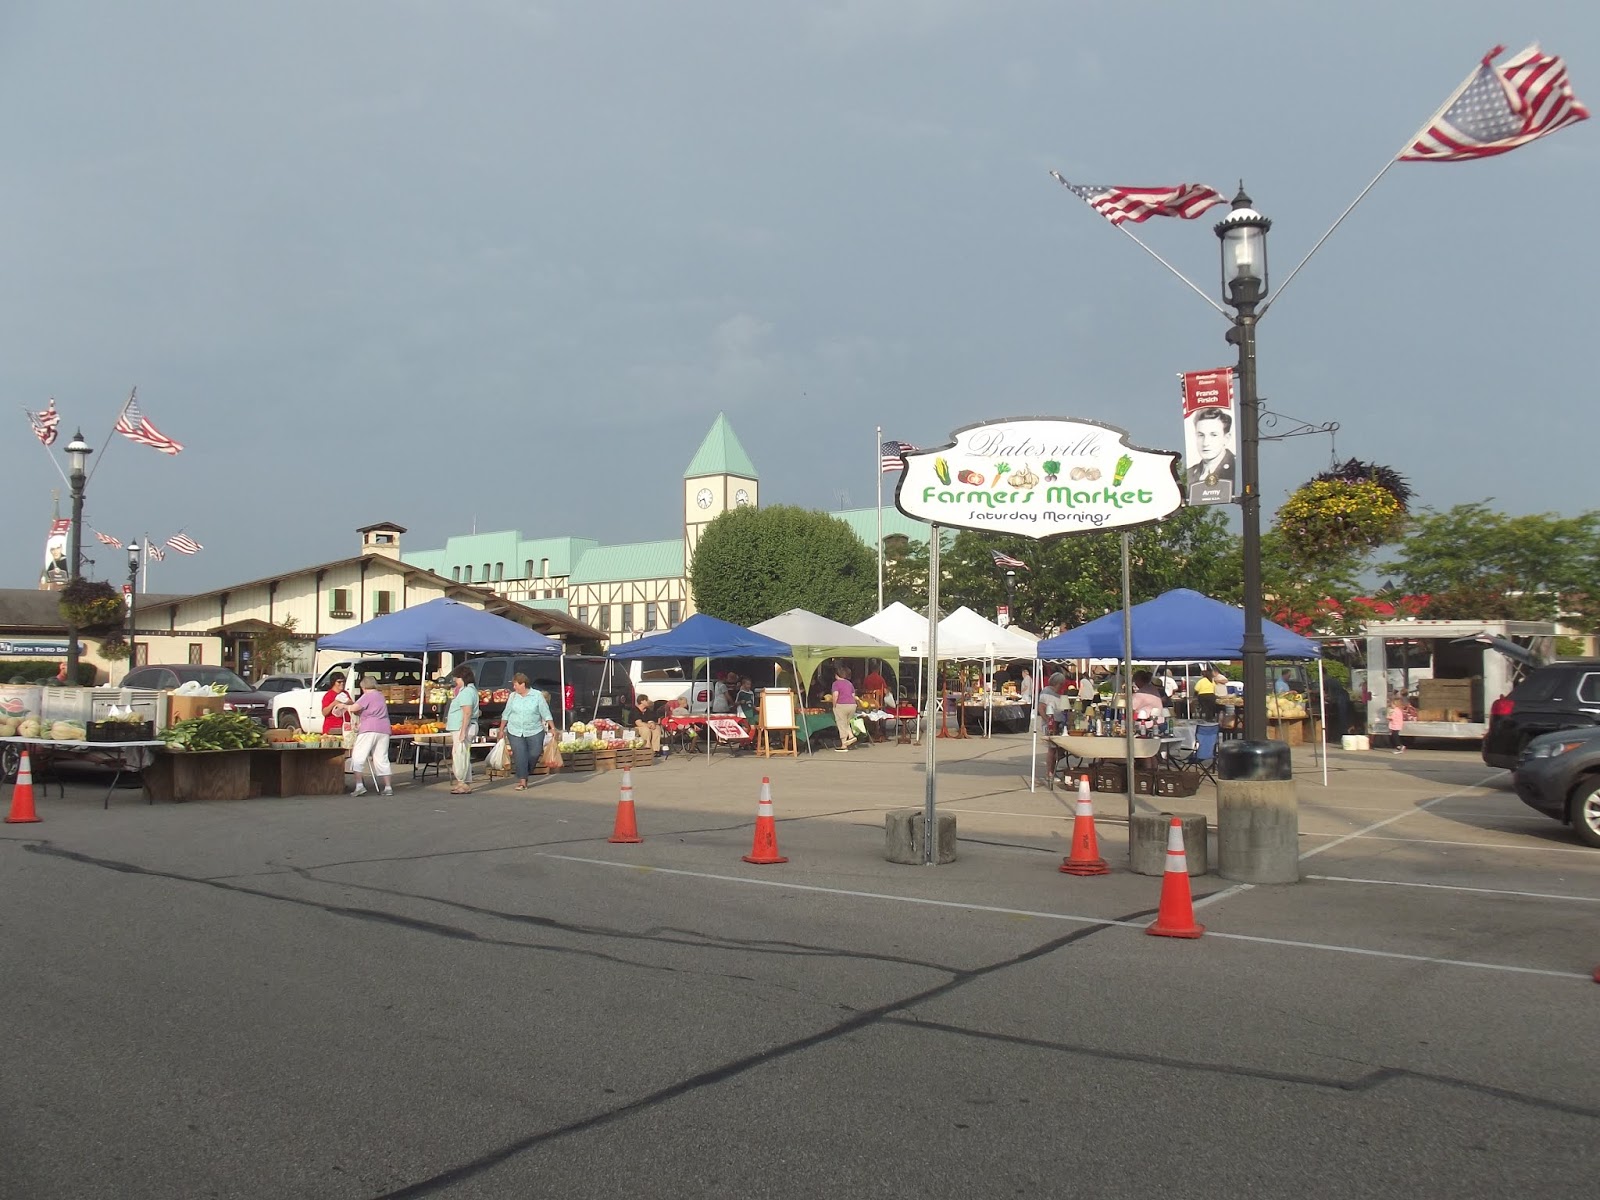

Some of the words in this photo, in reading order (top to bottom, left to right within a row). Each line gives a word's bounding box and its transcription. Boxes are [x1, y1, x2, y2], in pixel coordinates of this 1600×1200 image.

[965, 427, 1105, 458] Batesville
[922, 486, 1034, 509] Farmers
[1046, 486, 1153, 509] Market
[968, 510, 1037, 523] Saturday
[1043, 510, 1112, 527] Mornings
